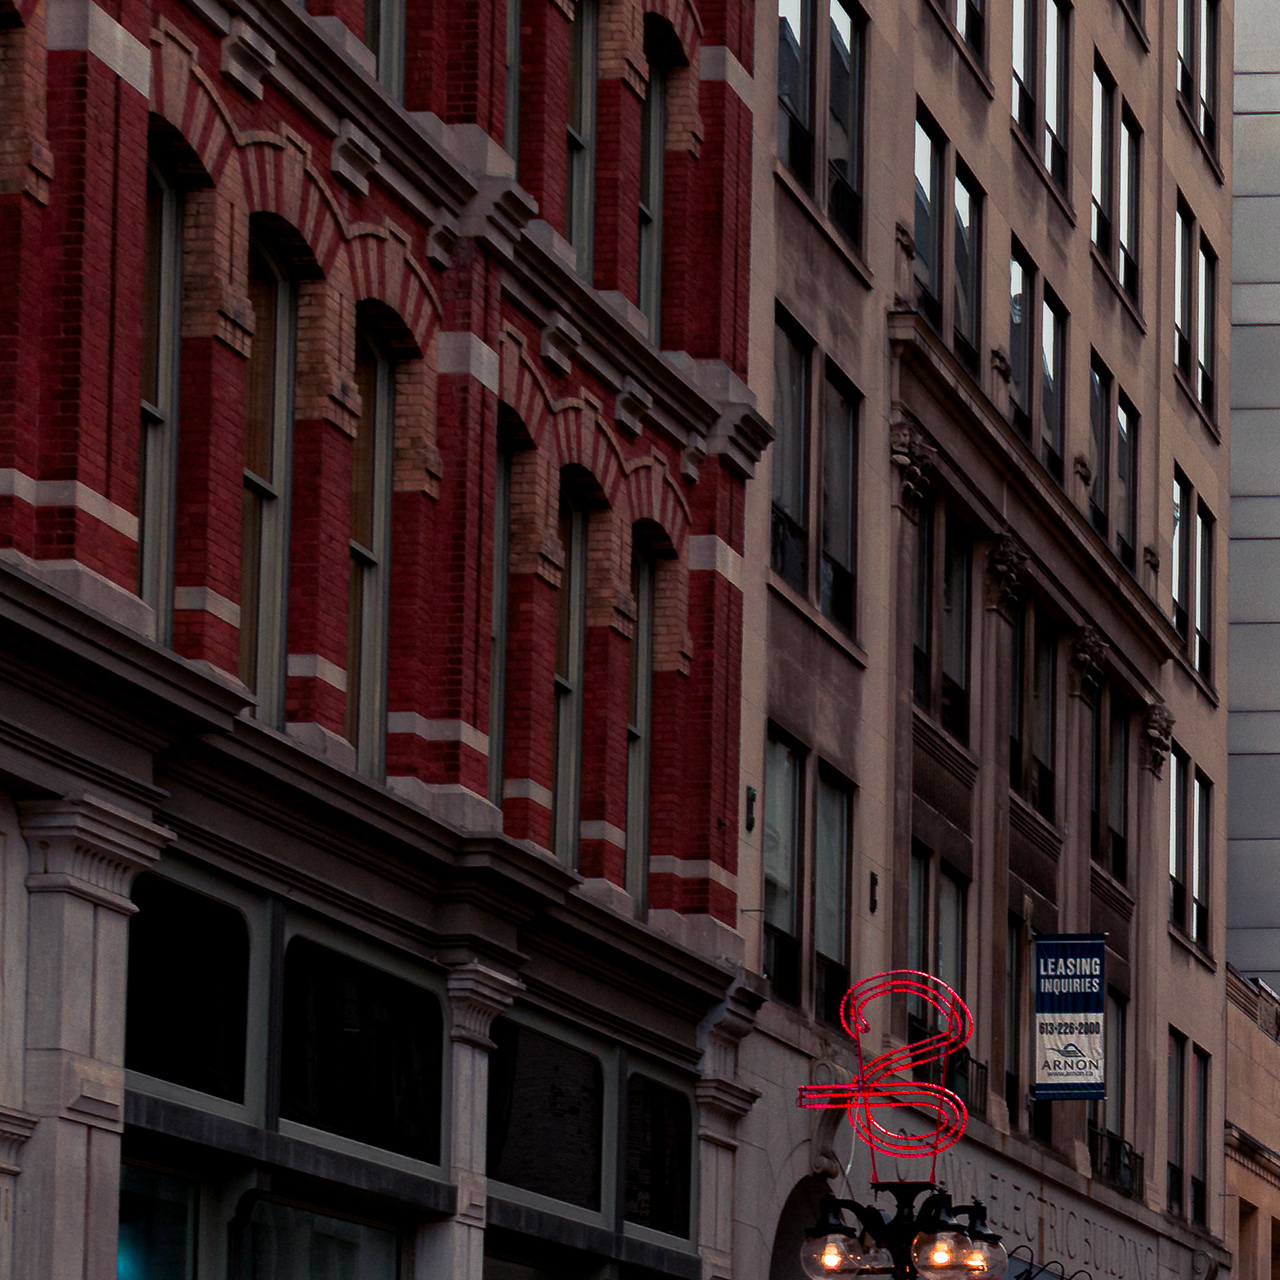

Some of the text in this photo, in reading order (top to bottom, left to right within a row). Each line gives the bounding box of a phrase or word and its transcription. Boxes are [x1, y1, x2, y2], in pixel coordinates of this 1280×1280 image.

[1039, 957, 1101, 976] LEASING
[1040, 978, 1100, 996] INQUIRIES
[1041, 1059, 1099, 1071] ARNON
[1046, 1070, 1094, 1079] www.arnon.ca
